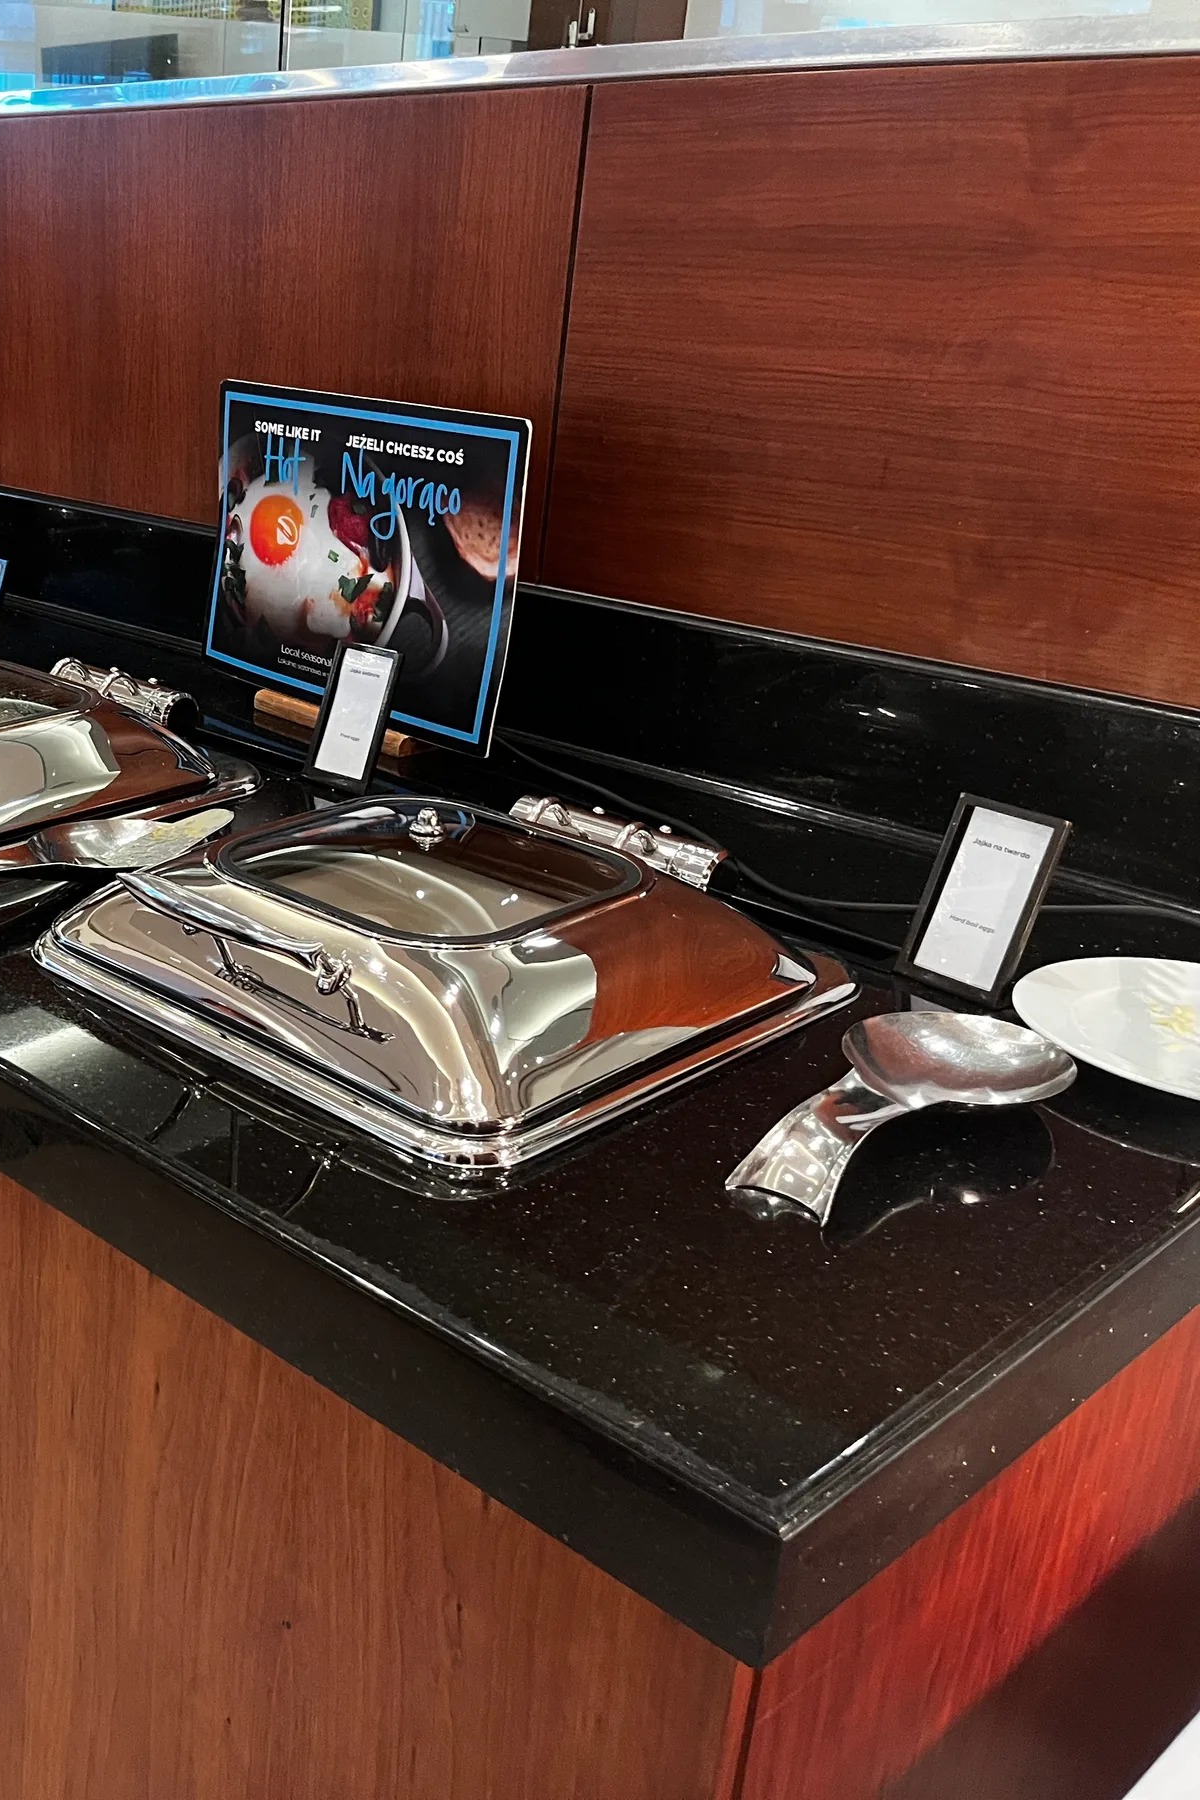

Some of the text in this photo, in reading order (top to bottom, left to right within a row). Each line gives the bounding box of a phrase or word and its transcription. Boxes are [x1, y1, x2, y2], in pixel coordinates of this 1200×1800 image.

[254, 420, 322, 442] SOME LIKE IT
[264, 432, 306, 496] Hot
[345, 433, 465, 466] JEŻELI CHCESZ COŚ
[341, 447, 461, 541] Na gorąco
[972, 837, 1031, 860] Jajka na twardo
